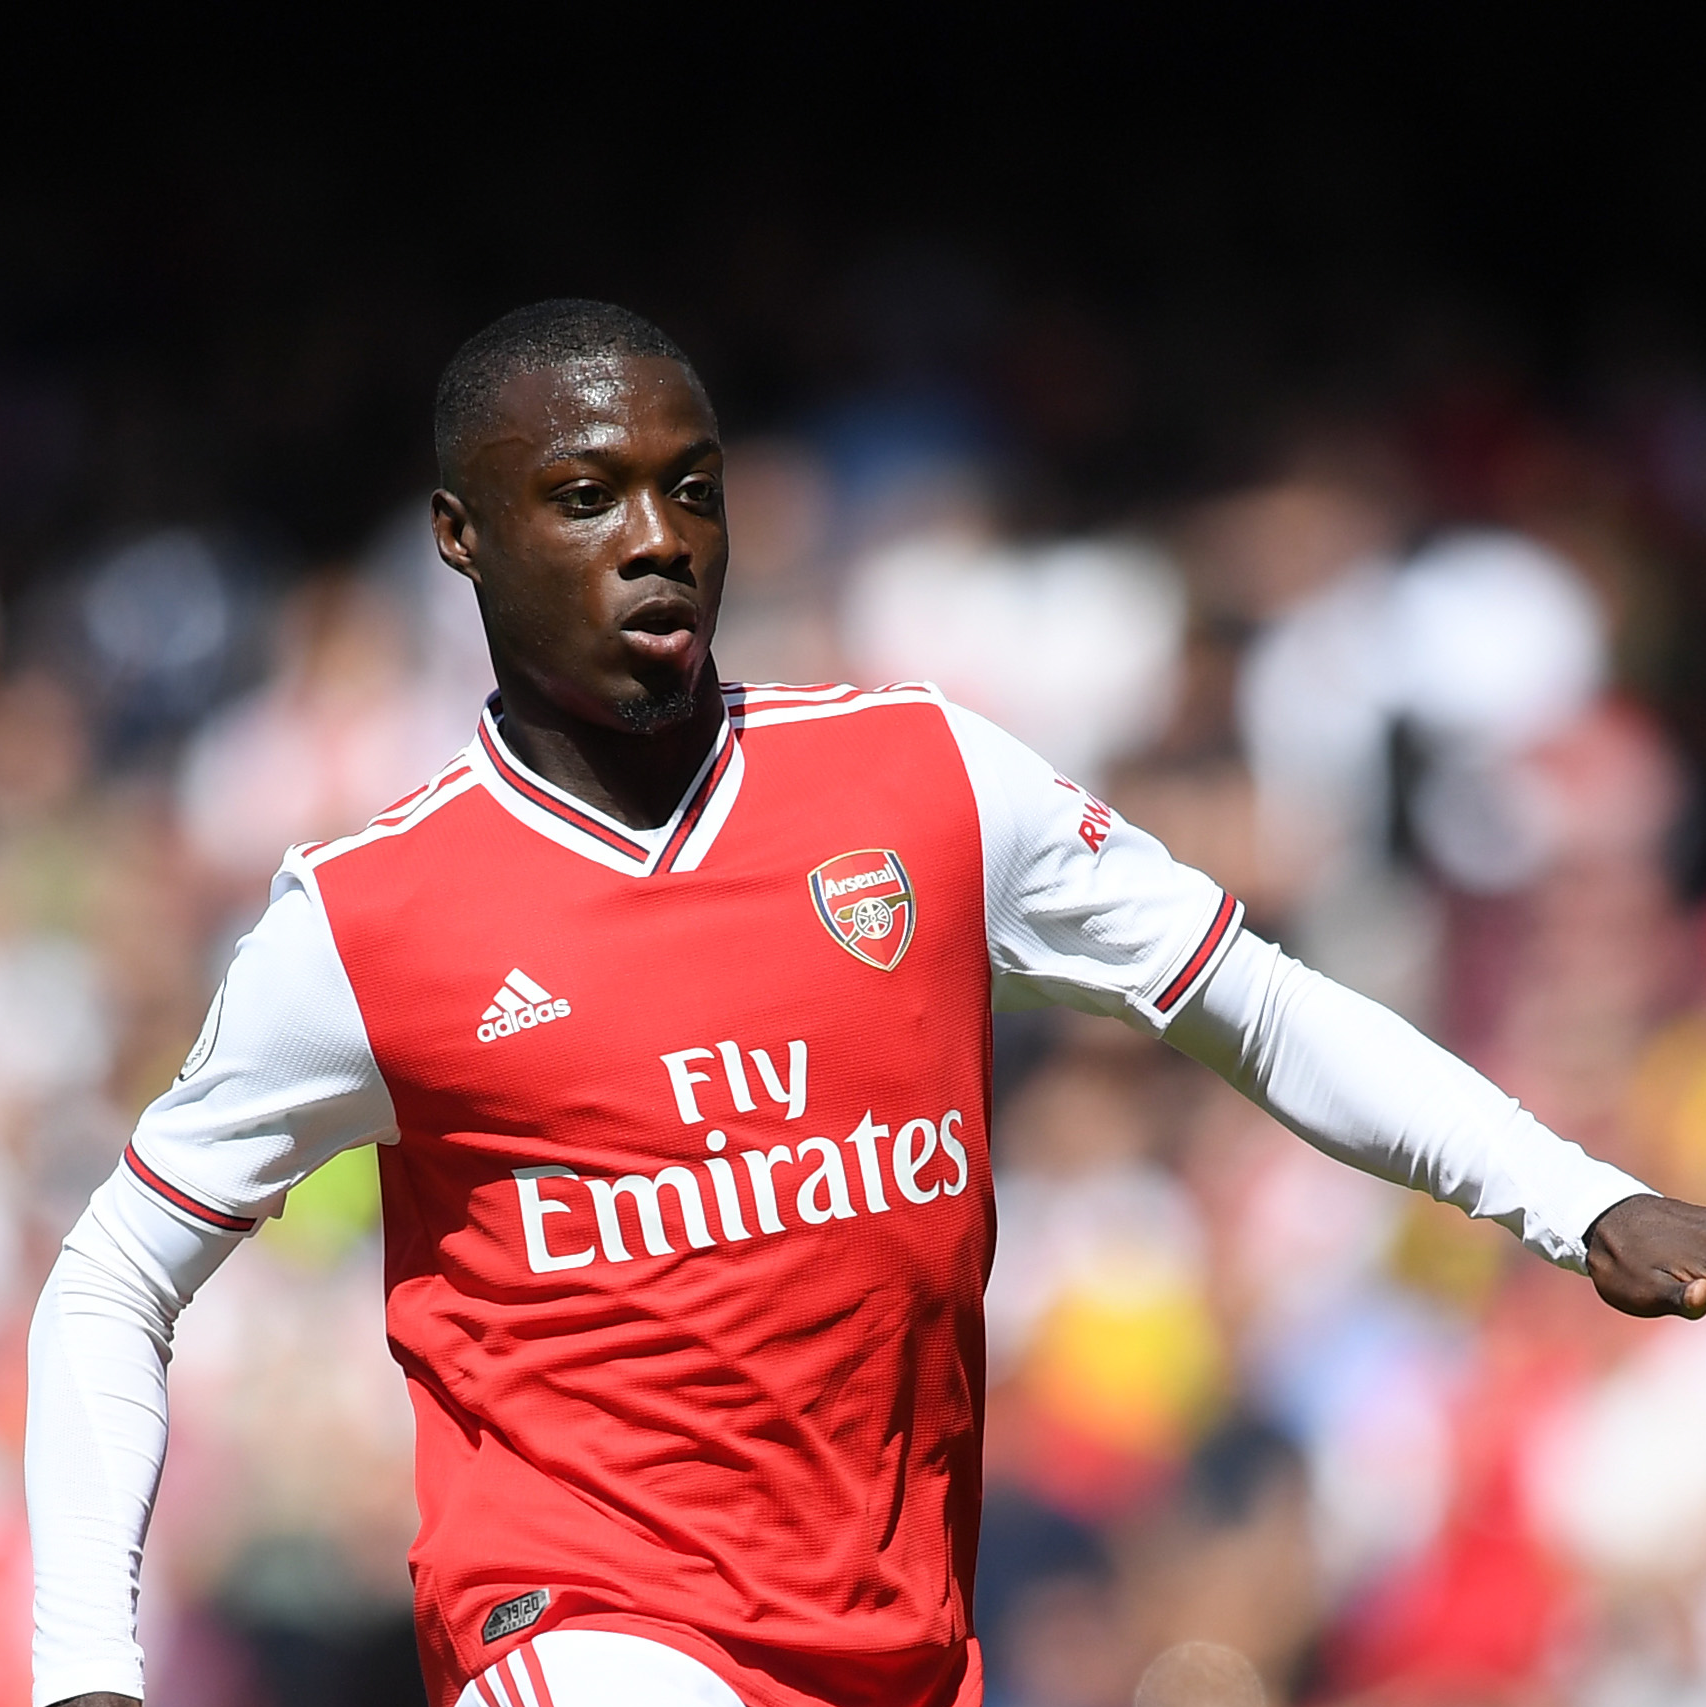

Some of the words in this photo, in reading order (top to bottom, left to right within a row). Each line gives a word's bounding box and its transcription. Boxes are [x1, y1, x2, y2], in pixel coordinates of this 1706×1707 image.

[824, 863, 896, 899] Arsenal
[476, 998, 572, 1043] adidas
[659, 1039, 808, 1125] Fly
[511, 1108, 969, 1274] Emirates
